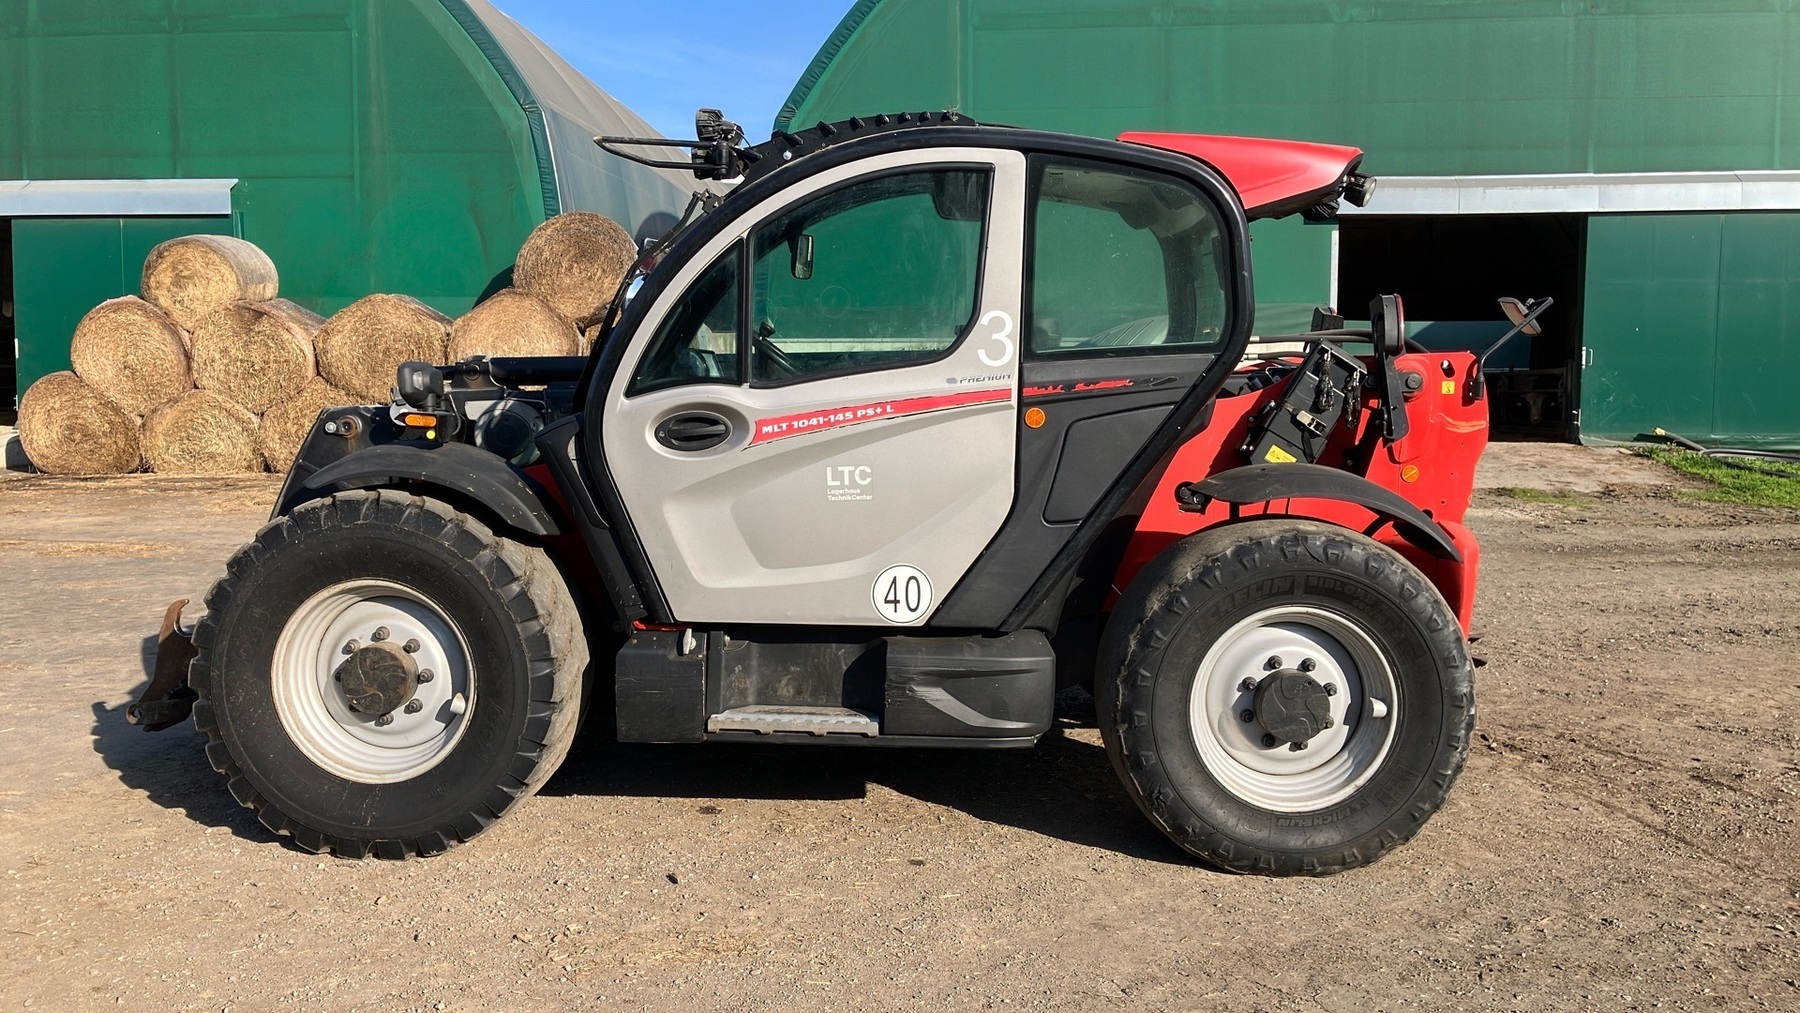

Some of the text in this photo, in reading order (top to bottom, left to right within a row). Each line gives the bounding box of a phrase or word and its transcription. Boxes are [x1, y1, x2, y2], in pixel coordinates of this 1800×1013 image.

[977, 310, 1014, 367] 3
[762, 405, 894, 434] MLT 1041-145 PS+ L
[826, 465, 872, 486] LTC
[884, 576, 921, 613] 40
[1277, 806, 1352, 827] MICHELIN
